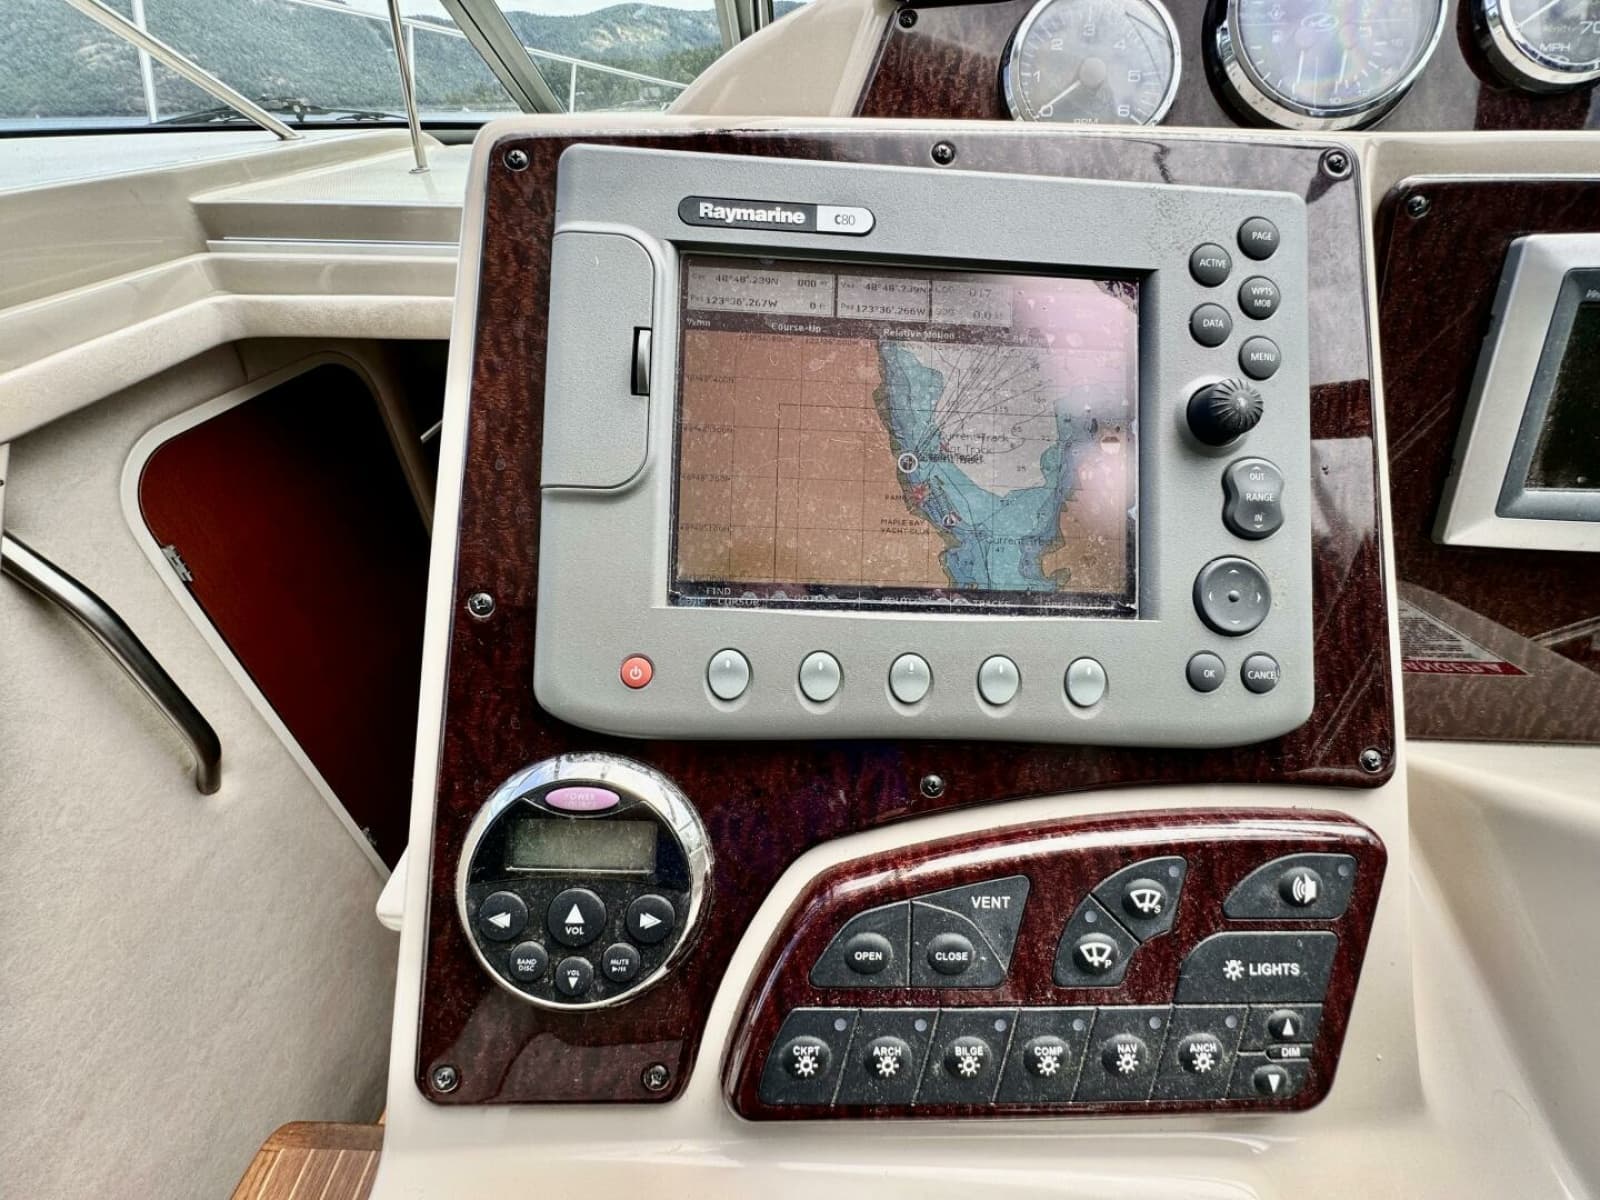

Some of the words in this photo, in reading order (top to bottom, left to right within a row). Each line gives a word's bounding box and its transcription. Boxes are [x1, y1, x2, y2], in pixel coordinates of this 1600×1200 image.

[1540, 43, 1571, 52] MPH
[698, 202, 806, 226] Raymarine
[834, 213, 856, 227] C80
[1252, 231, 1273, 241] PAGE
[1199, 258, 1227, 269] ACTIVE
[1251, 287, 1273, 296] WPTS
[1254, 299, 1271, 308] MOB
[1203, 319, 1224, 329] DATA
[883, 328, 924, 339] Relative
[1250, 353, 1276, 362] MENU
[1250, 473, 1265, 481] OUT
[1246, 493, 1274, 502] RANGE
[1254, 514, 1263, 522] IN
[706, 587, 731, 595] FIND
[1204, 669, 1215, 678] OK
[1248, 670, 1280, 681] CANCEL
[971, 896, 1011, 909] VENT
[565, 926, 585, 936] VOL
[854, 952, 883, 962] OPEN
[935, 952, 969, 962] CLOSE
[1249, 963, 1300, 977] LIGHTS
[792, 1047, 820, 1057] CKPT
[872, 1047, 902, 1057] ARCH
[954, 1047, 983, 1057] BILGE
[1034, 1046, 1063, 1056] COMP
[1117, 1044, 1137, 1054] NAV
[1189, 1043, 1217, 1053] ANCH
[1281, 1047, 1301, 1058] DIM
